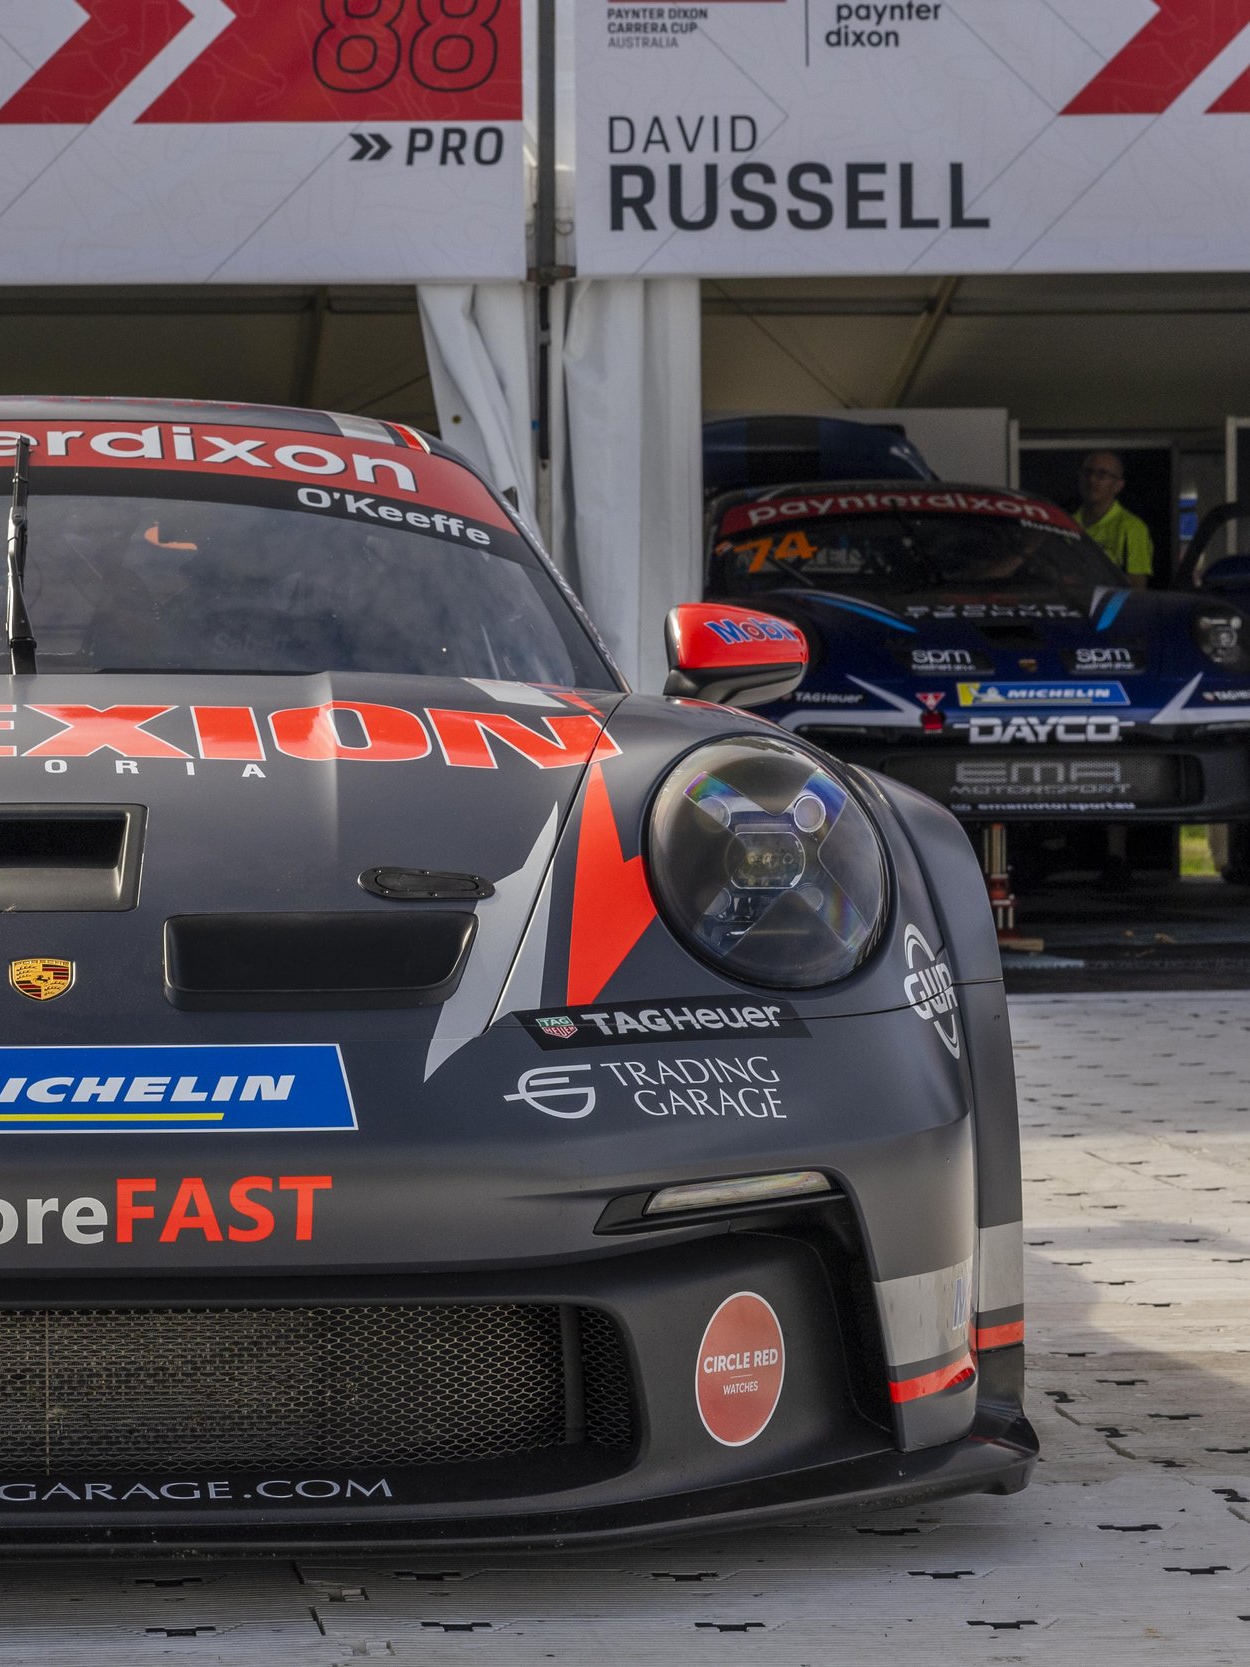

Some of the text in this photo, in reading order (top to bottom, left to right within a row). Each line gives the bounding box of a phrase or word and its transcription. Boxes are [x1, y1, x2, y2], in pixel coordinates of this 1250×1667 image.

[607, 7, 709, 20] PAYNTER DIXON
[836, 0, 941, 26] paynter
[607, 22, 699, 35] CARRERA CUP
[825, 24, 900, 48] dixon
[311, 0, 499, 92] 88
[607, 36, 679, 49] AUSTRALIA
[405, 127, 505, 166] PRO
[608, 115, 758, 153] DAVID
[610, 162, 991, 231] RUSSELL
[296, 487, 491, 546] O'Keeffe
[734, 531, 818, 573] 74
[703, 618, 799, 645] Mobil
[1006, 687, 1111, 699] MICHELIN
[968, 716, 1120, 744] DAYCO
[542, 1018, 569, 1026] TAG
[599, 1056, 781, 1086] TRADING
[633, 1087, 788, 1119] GARAGE
[703, 1348, 779, 1374] CIRCLE RED
[722, 1380, 759, 1396] WATCHES
